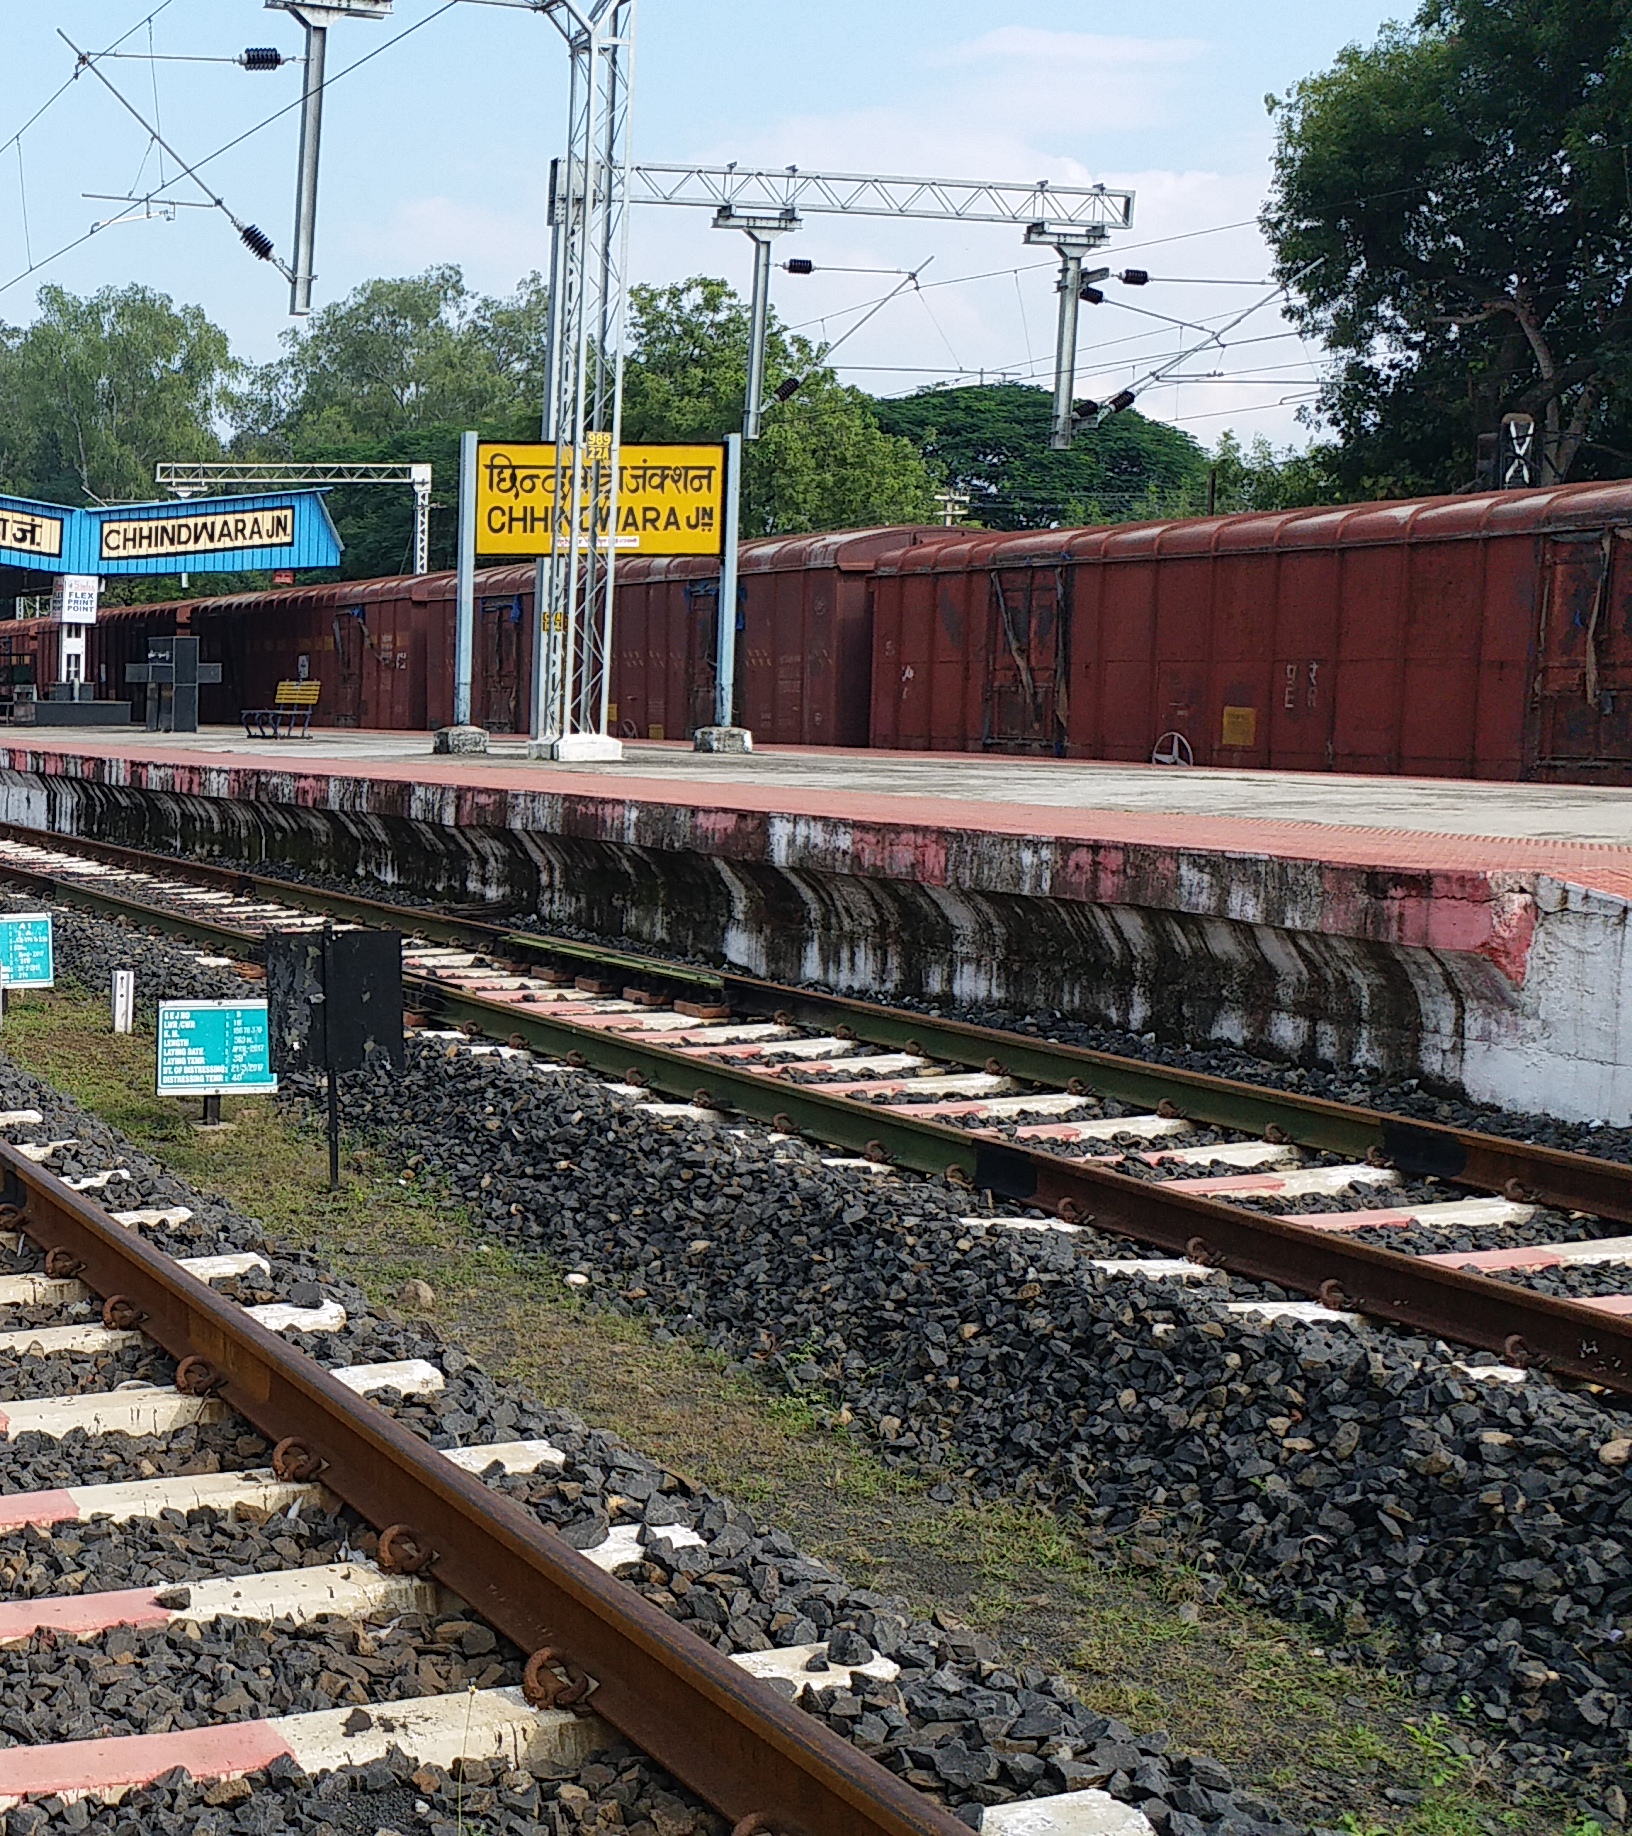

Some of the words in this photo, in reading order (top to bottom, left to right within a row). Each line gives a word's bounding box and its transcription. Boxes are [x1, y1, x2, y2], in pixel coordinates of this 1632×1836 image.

[587, 433, 612, 446] 989
[623, 458, 717, 494] जंक्शन
[104, 516, 263, 551] CHHINDWARA
[68, 591, 94, 599] FLEX
[164, 1039, 189, 1047] LENGTH
[163, 1049, 186, 1057] LAYING
[187, 1047, 204, 1055] DATE
[163, 1058, 186, 1066] LAYING
